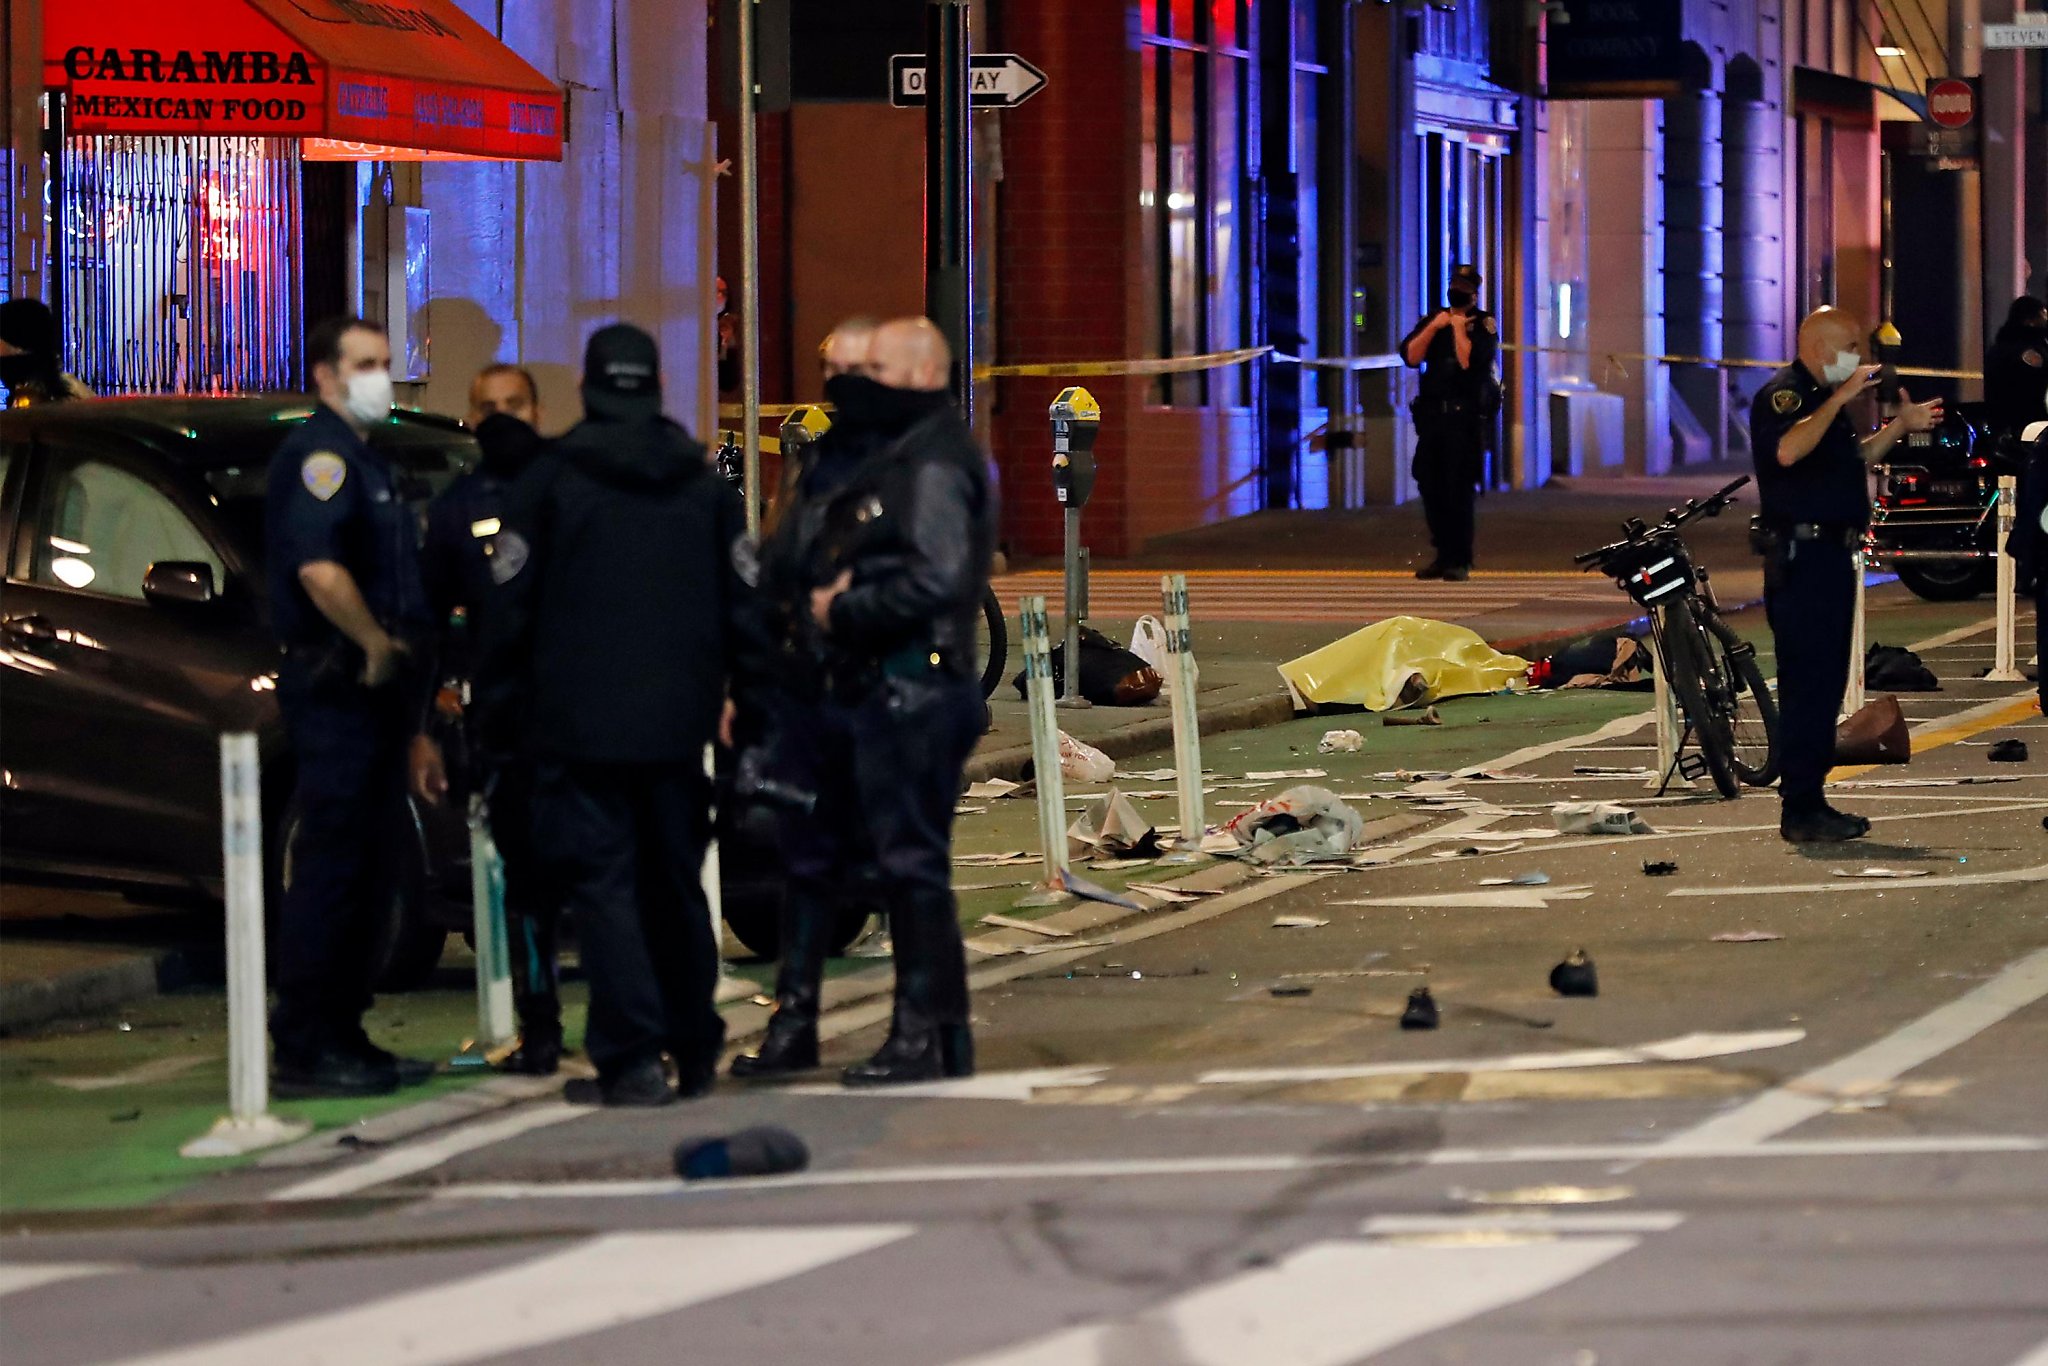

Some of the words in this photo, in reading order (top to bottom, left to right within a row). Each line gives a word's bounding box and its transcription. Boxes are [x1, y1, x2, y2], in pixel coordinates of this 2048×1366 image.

[64, 46, 315, 85] CARAMBA
[970, 72, 1000, 90] AY
[75, 95, 213, 119] MEXICAN
[223, 98, 306, 120] FOOD
